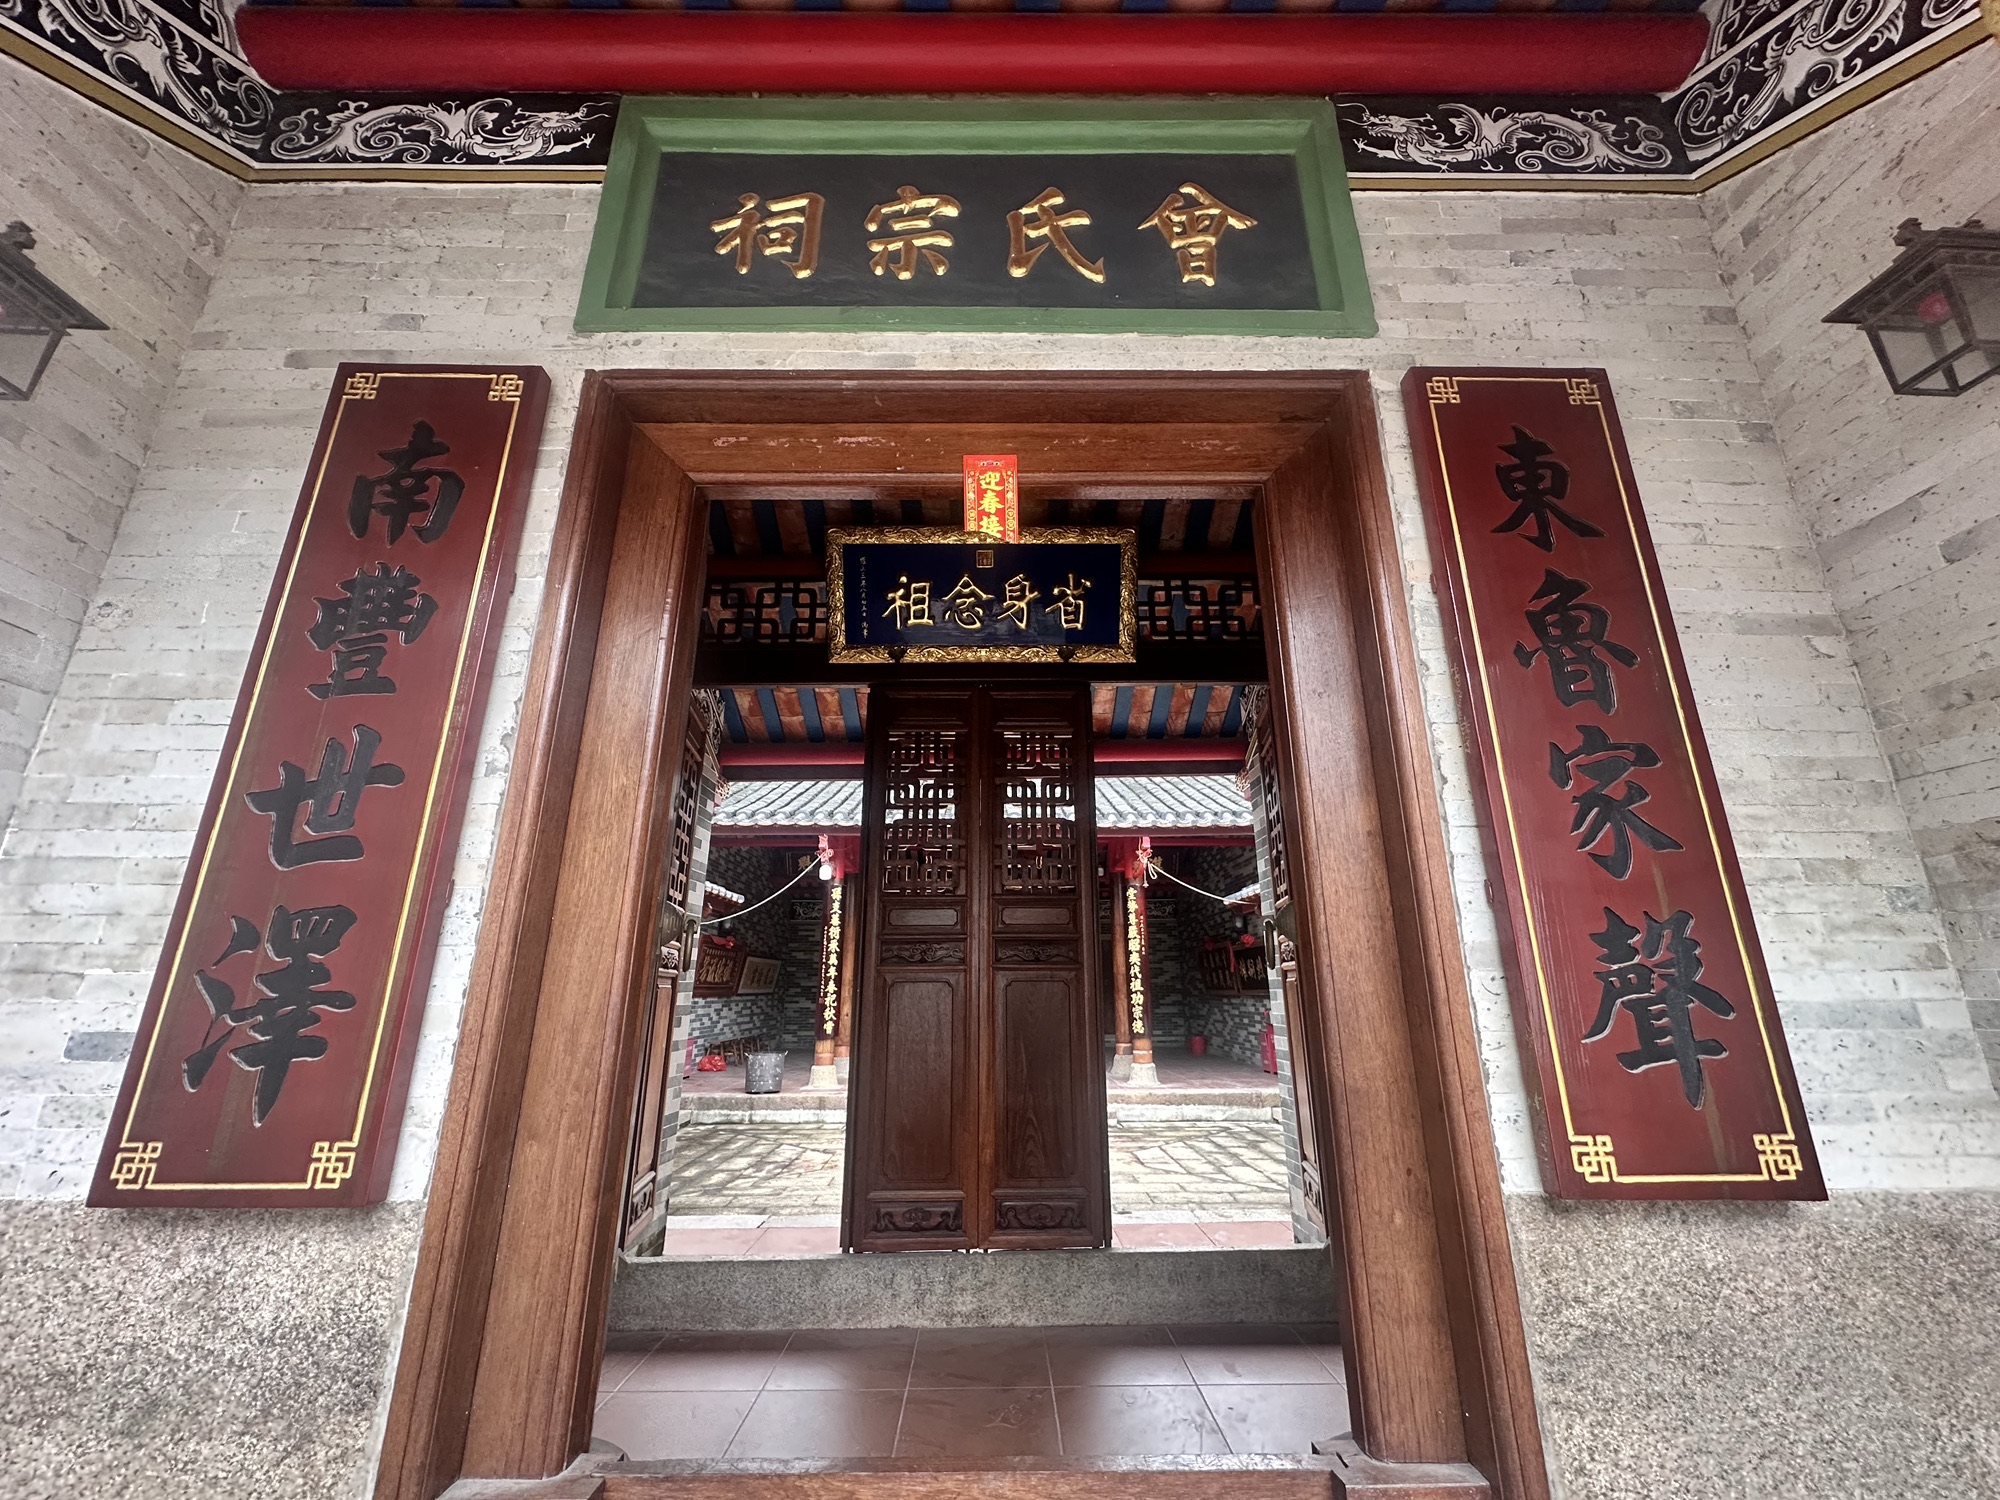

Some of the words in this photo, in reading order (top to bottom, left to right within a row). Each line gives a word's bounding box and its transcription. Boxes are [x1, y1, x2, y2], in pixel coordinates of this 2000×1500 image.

[182, 420, 466, 1127] 南豐世澤
[882, 573, 1091, 631] 省身念祖
[1490, 424, 1736, 1111] 東魯家聲
